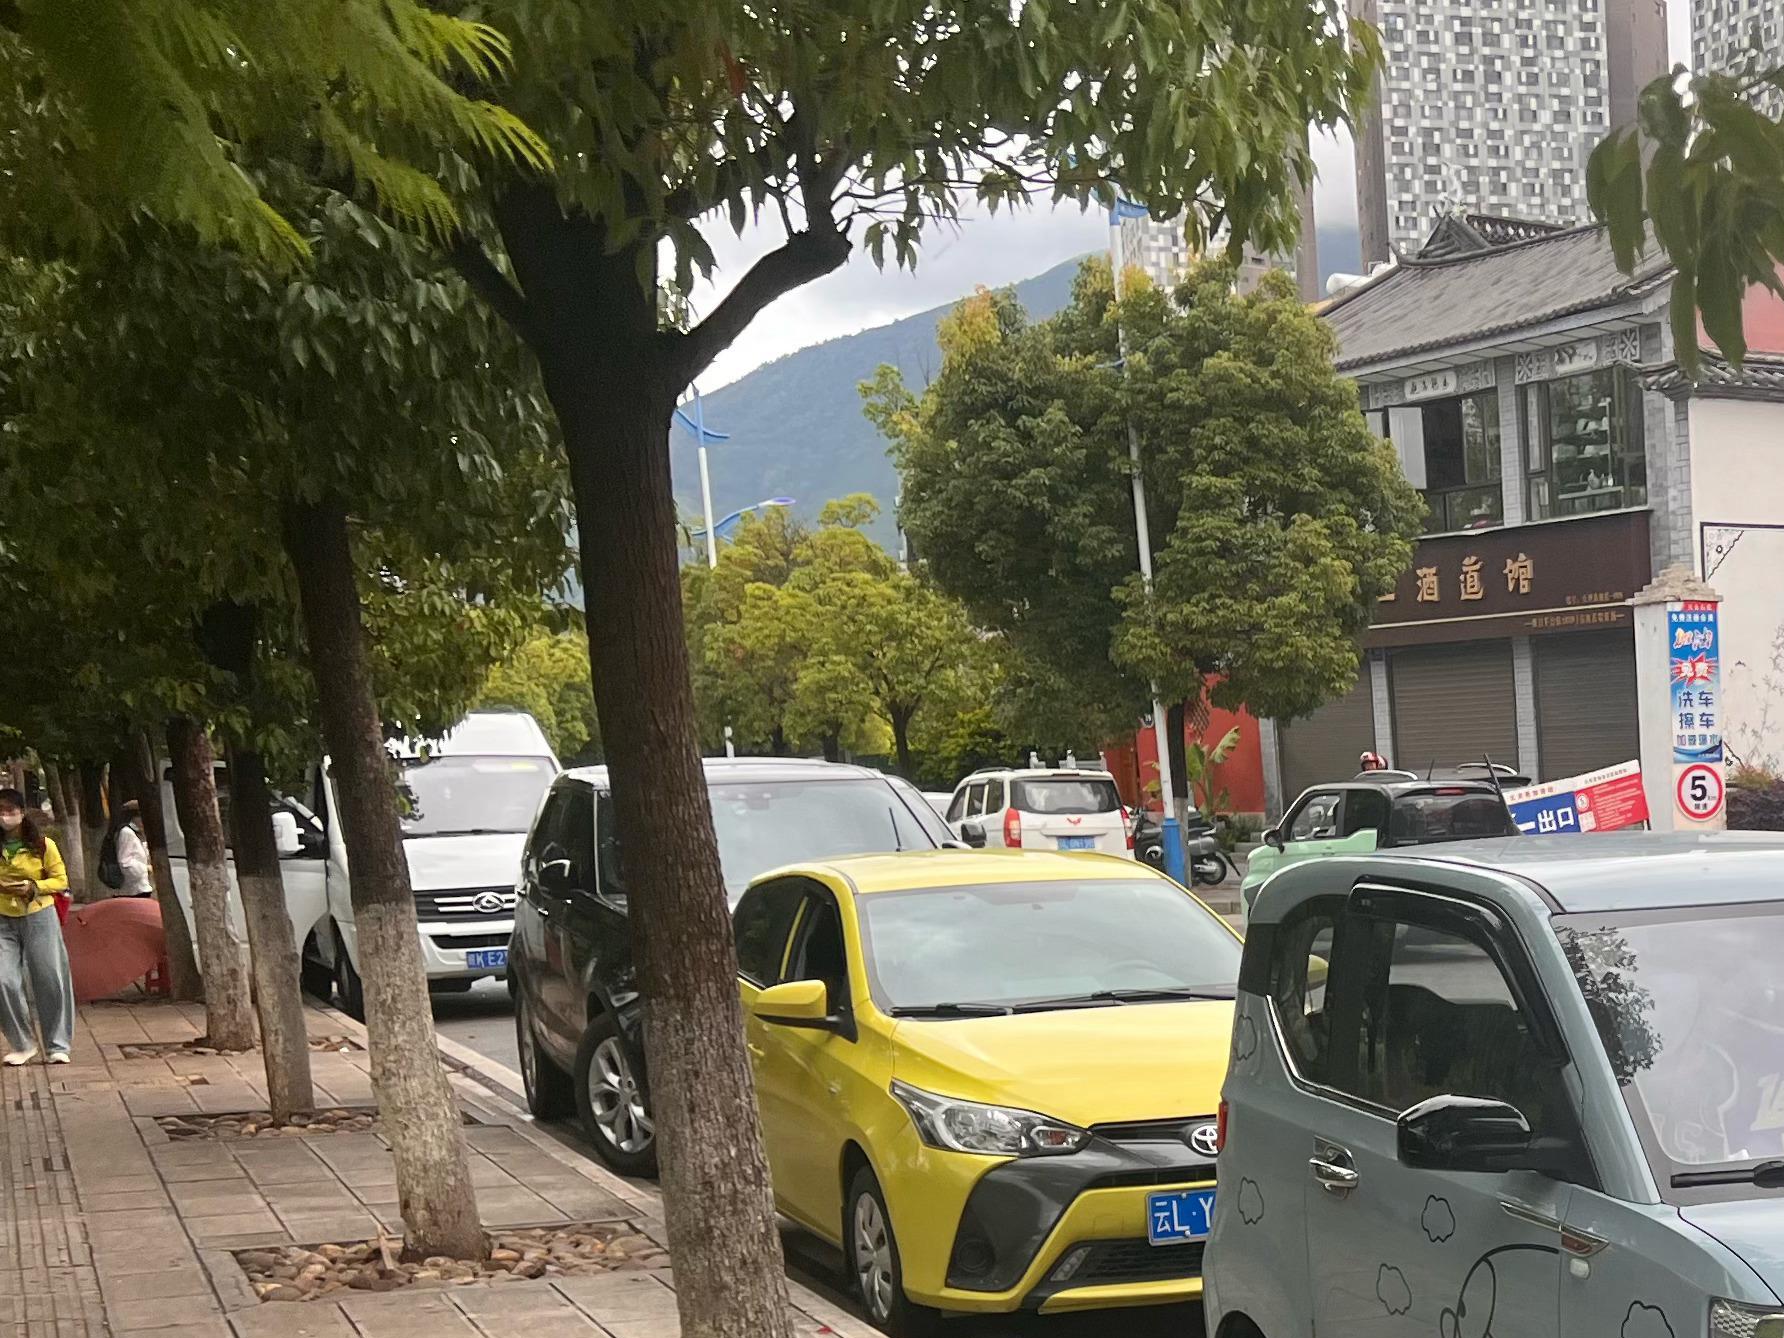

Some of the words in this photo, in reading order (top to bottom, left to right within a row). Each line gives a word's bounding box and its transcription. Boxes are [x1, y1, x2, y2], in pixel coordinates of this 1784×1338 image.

[1376, 552, 1535, 603] 酒道馆
[1679, 691, 1714, 708] 洗车
[1679, 712, 1715, 730] 擦车
[1690, 775, 1708, 801] 5
[1537, 806, 1575, 833] 出口
